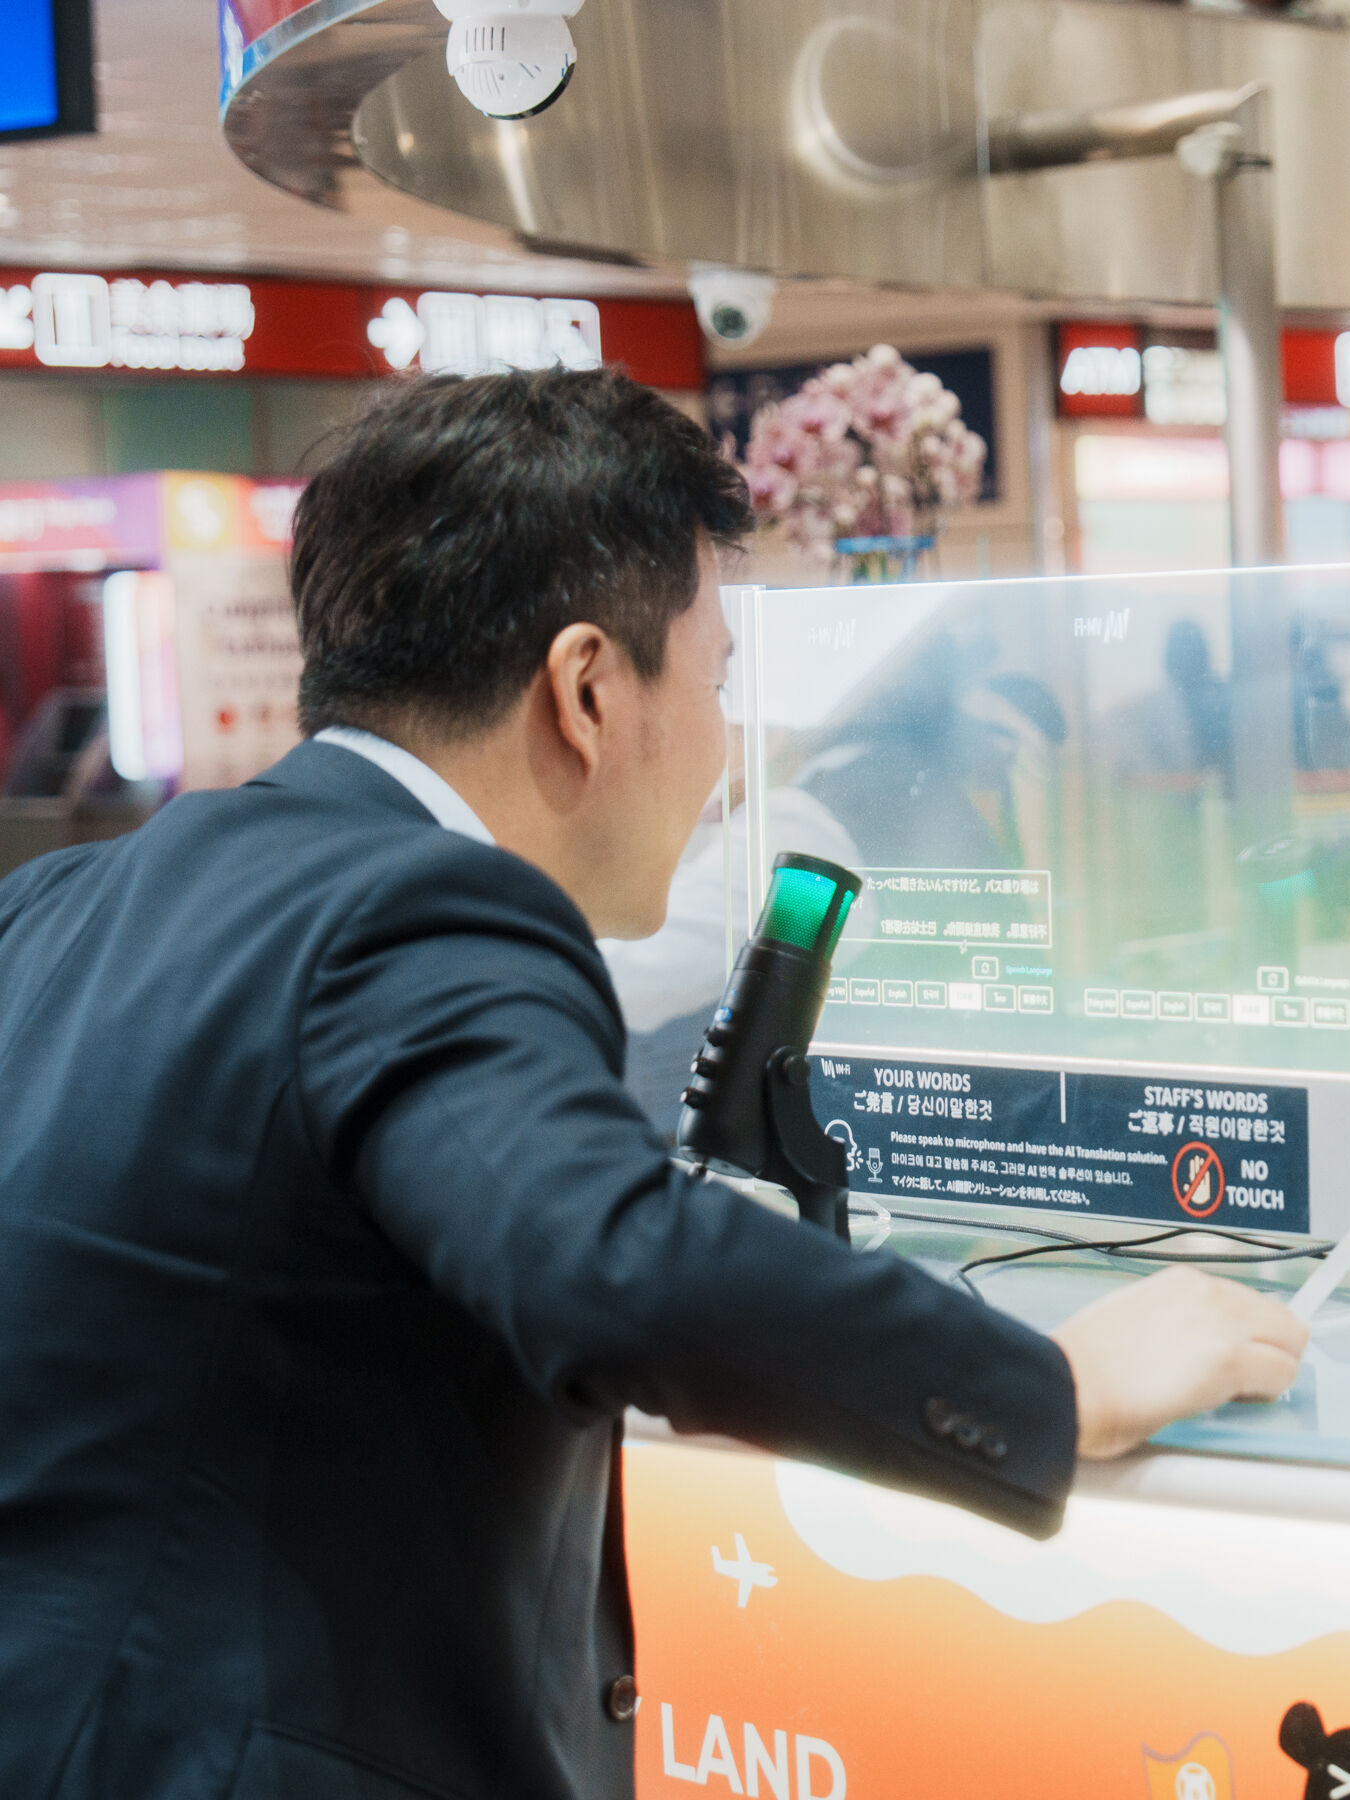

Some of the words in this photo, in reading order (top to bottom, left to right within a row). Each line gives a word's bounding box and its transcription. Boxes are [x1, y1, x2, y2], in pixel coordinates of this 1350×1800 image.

[874, 1068, 914, 1088] YOUR
[917, 1071, 971, 1092] WORDS
[854, 1090, 894, 1114] ご発言
[907, 1094, 992, 1121] 당신이말한것
[1144, 1085, 1204, 1109] STAFF'S
[1205, 1090, 1268, 1114] WORDS
[1189, 1114, 1285, 1144] 직원이말한것
[890, 1131, 916, 1144] Please
[918, 1134, 943, 1147] speak
[944, 1136, 954, 1147] to
[955, 1137, 1005, 1152] microphone
[1007, 1141, 1024, 1153] and
[1025, 1141, 1047, 1155] have
[1048, 1143, 1064, 1156] the
[1065, 1145, 1075, 1157] AI
[1076, 1145, 1126, 1161] Translation
[1127, 1150, 1168, 1165] solution.
[891, 1152, 923, 1167] 마이크에
[925, 1155, 942, 1169] 대고
[944, 1157, 969, 1171] 말씀해
[971, 1159, 999, 1175] 주세요,
[1000, 1161, 1026, 1176] 그러면
[1027, 1164, 1037, 1177] AI
[1039, 1165, 1057, 1179] 번역
[1058, 1166, 1093, 1182] 솔루션이
[1095, 1169, 1134, 1186] 있습니다.
[1240, 1159, 1268, 1181] NO
[1225, 1185, 1285, 1210] TOUCH
[661, 1701, 847, 1800] LAND
